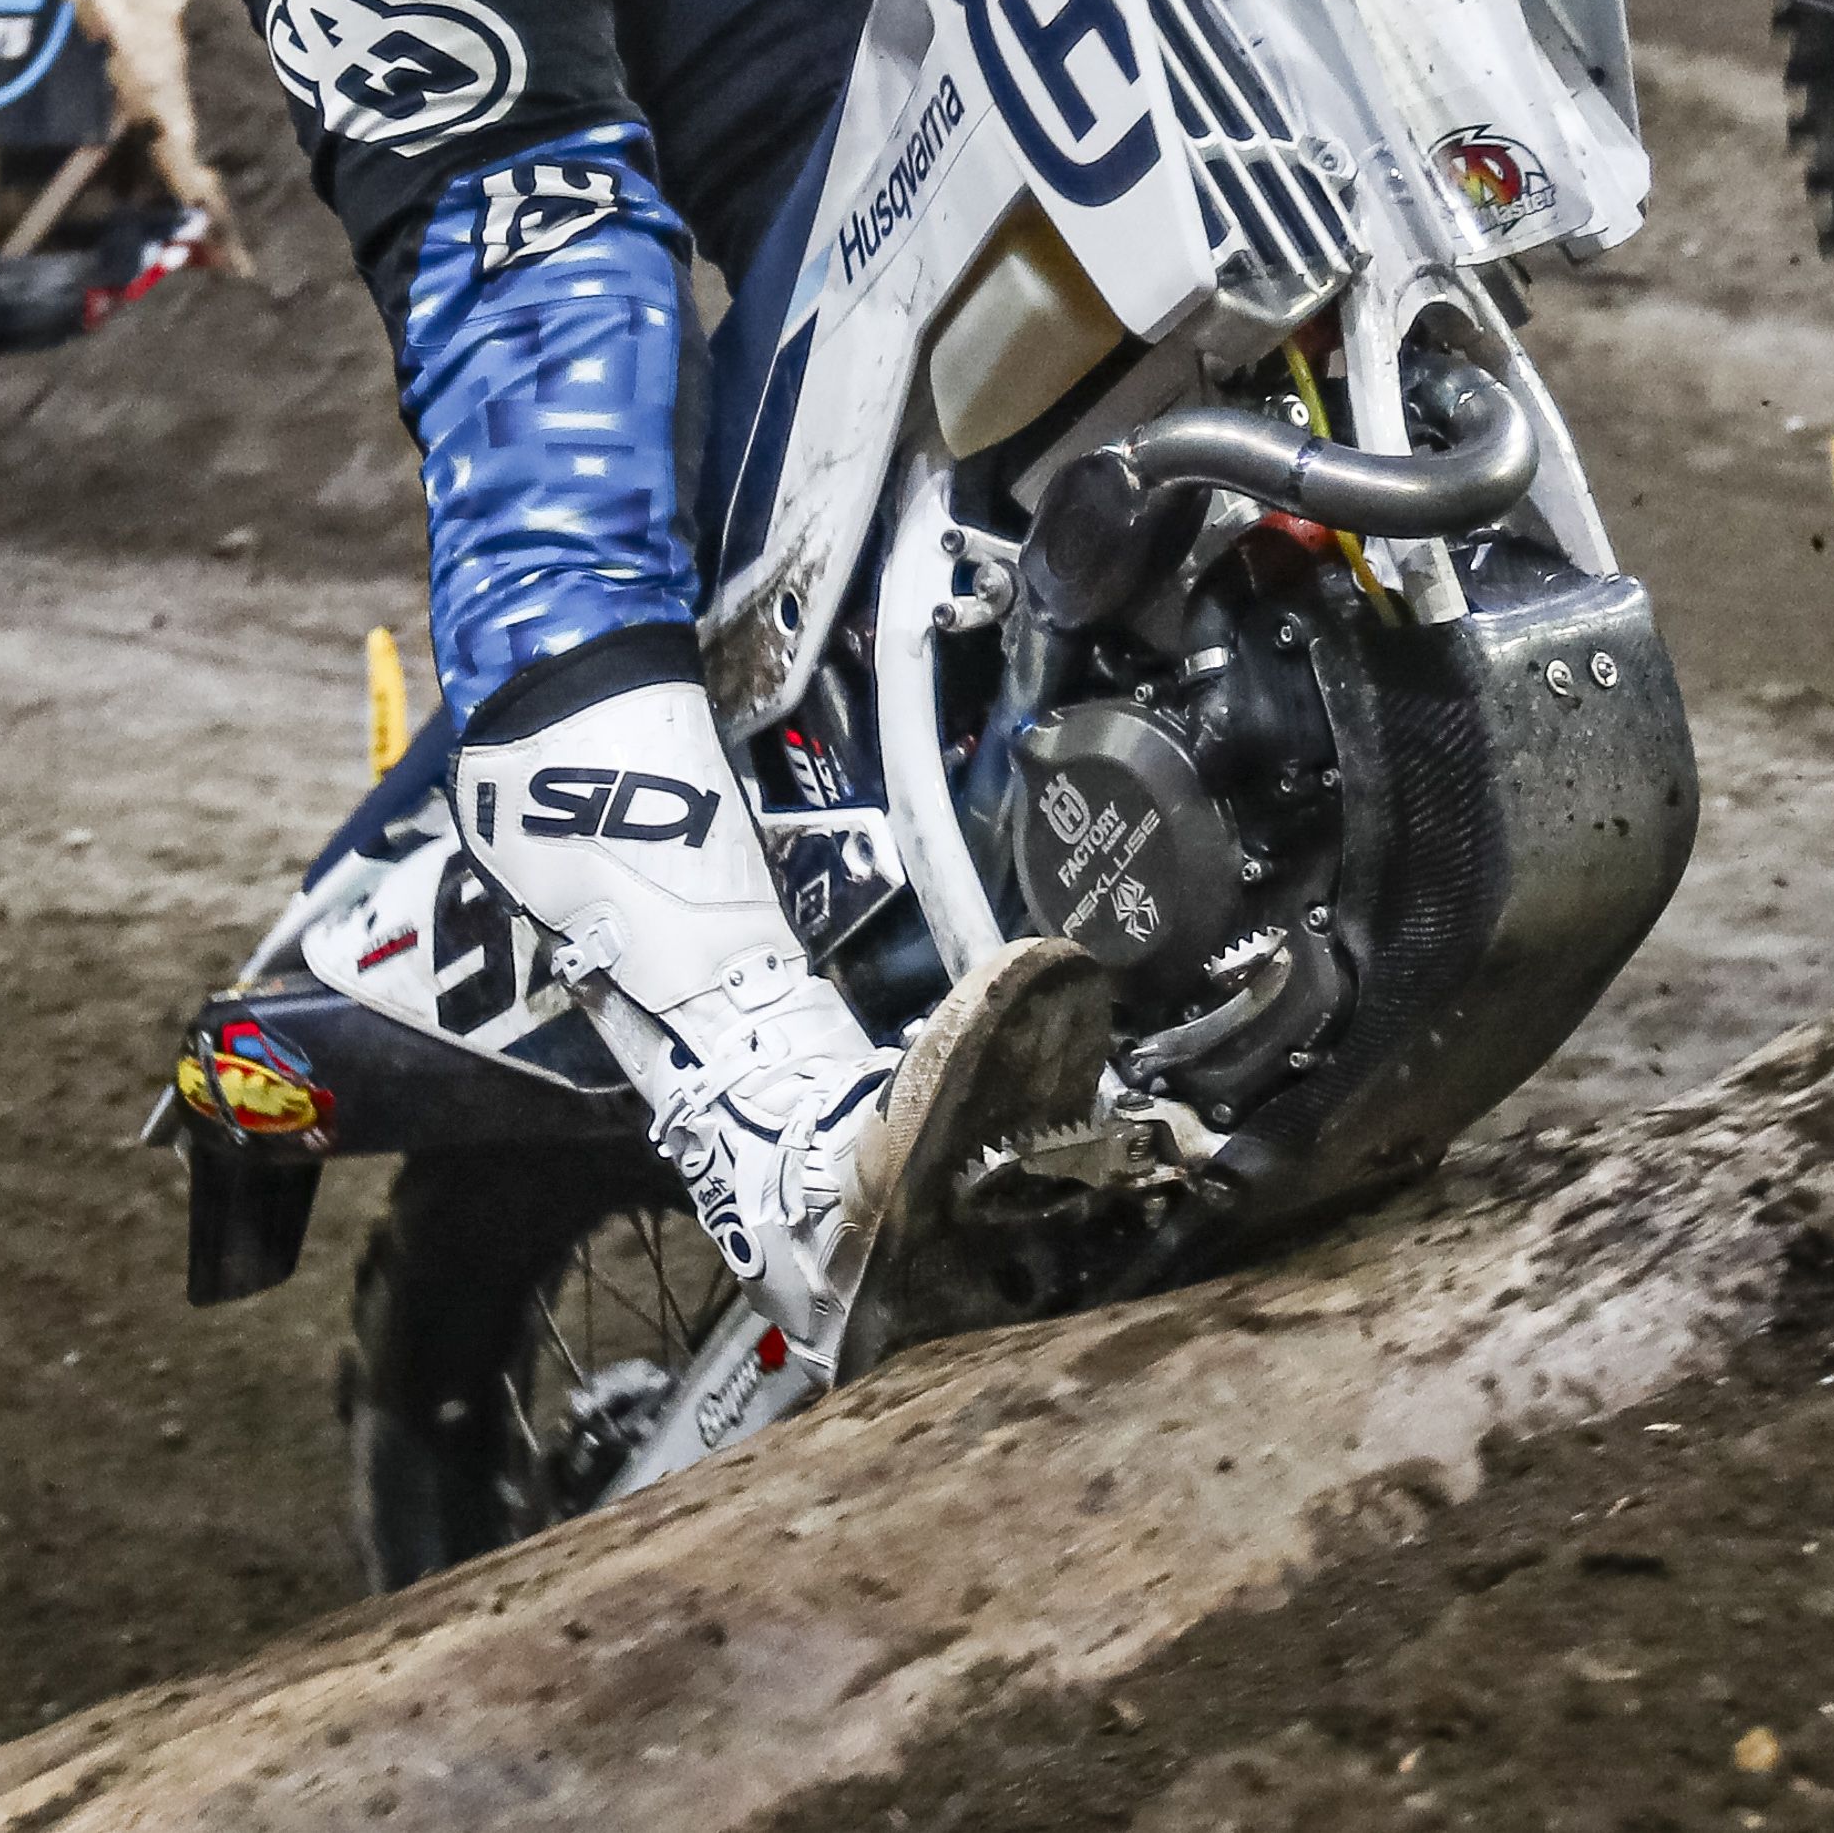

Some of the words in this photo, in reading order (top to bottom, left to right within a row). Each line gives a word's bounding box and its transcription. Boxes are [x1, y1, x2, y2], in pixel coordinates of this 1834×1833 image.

[838, 73, 966, 286] Husqvarna
[1057, 801, 1121, 888] FACTORY
[1062, 808, 1162, 940] REKLUSE
